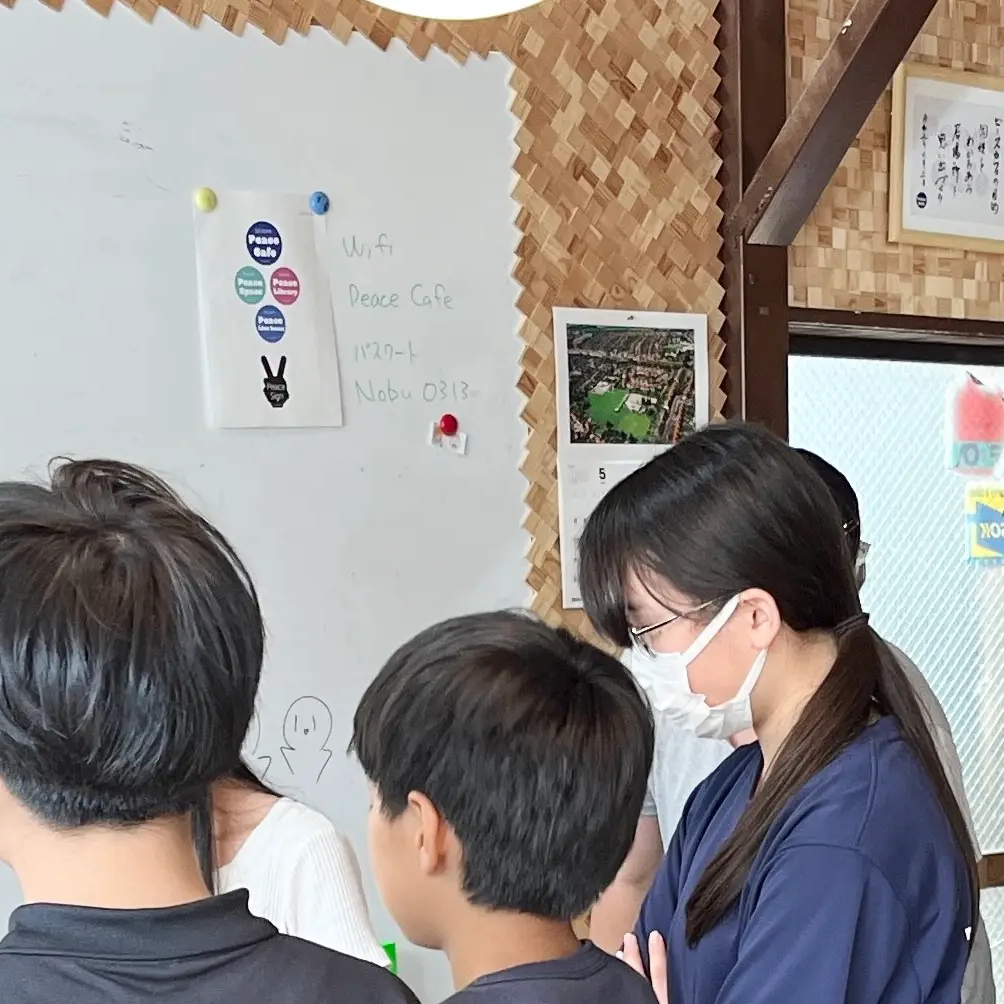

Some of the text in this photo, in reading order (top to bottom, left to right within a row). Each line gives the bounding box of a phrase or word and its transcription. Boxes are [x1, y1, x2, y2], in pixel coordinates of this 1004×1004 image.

[348, 283, 454, 310] Peace Cafe
[355, 378, 412, 404] Nobu
[599, 467, 606, 480] 5
